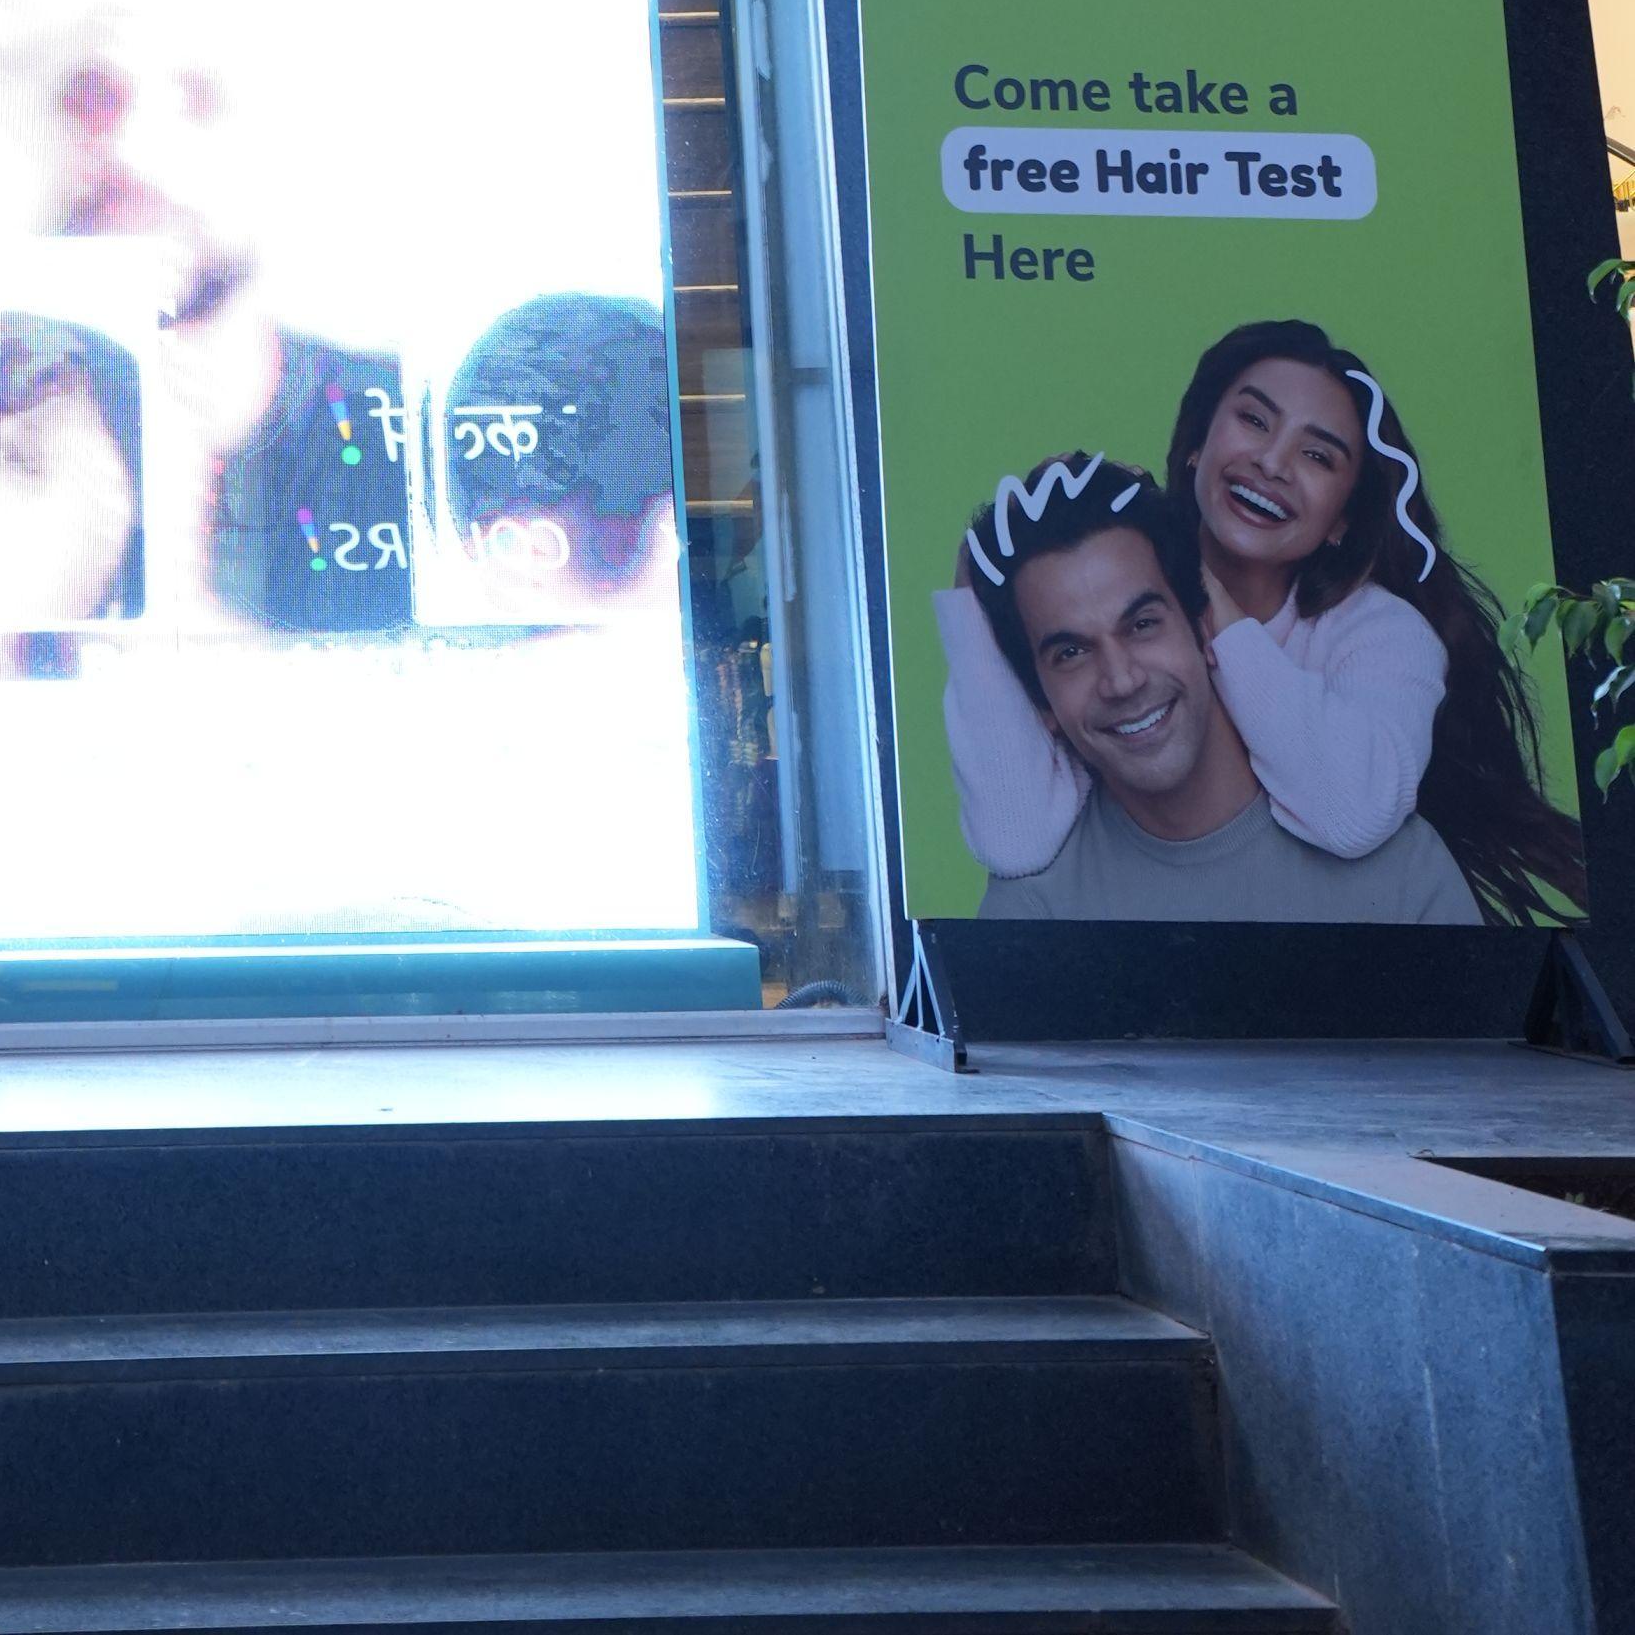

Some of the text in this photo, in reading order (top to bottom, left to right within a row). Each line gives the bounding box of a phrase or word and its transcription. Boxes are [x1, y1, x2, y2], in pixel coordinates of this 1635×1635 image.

[954, 63, 1299, 116] Come take a
[963, 144, 1343, 199] free Hair Test
[964, 234, 1095, 282] Here
